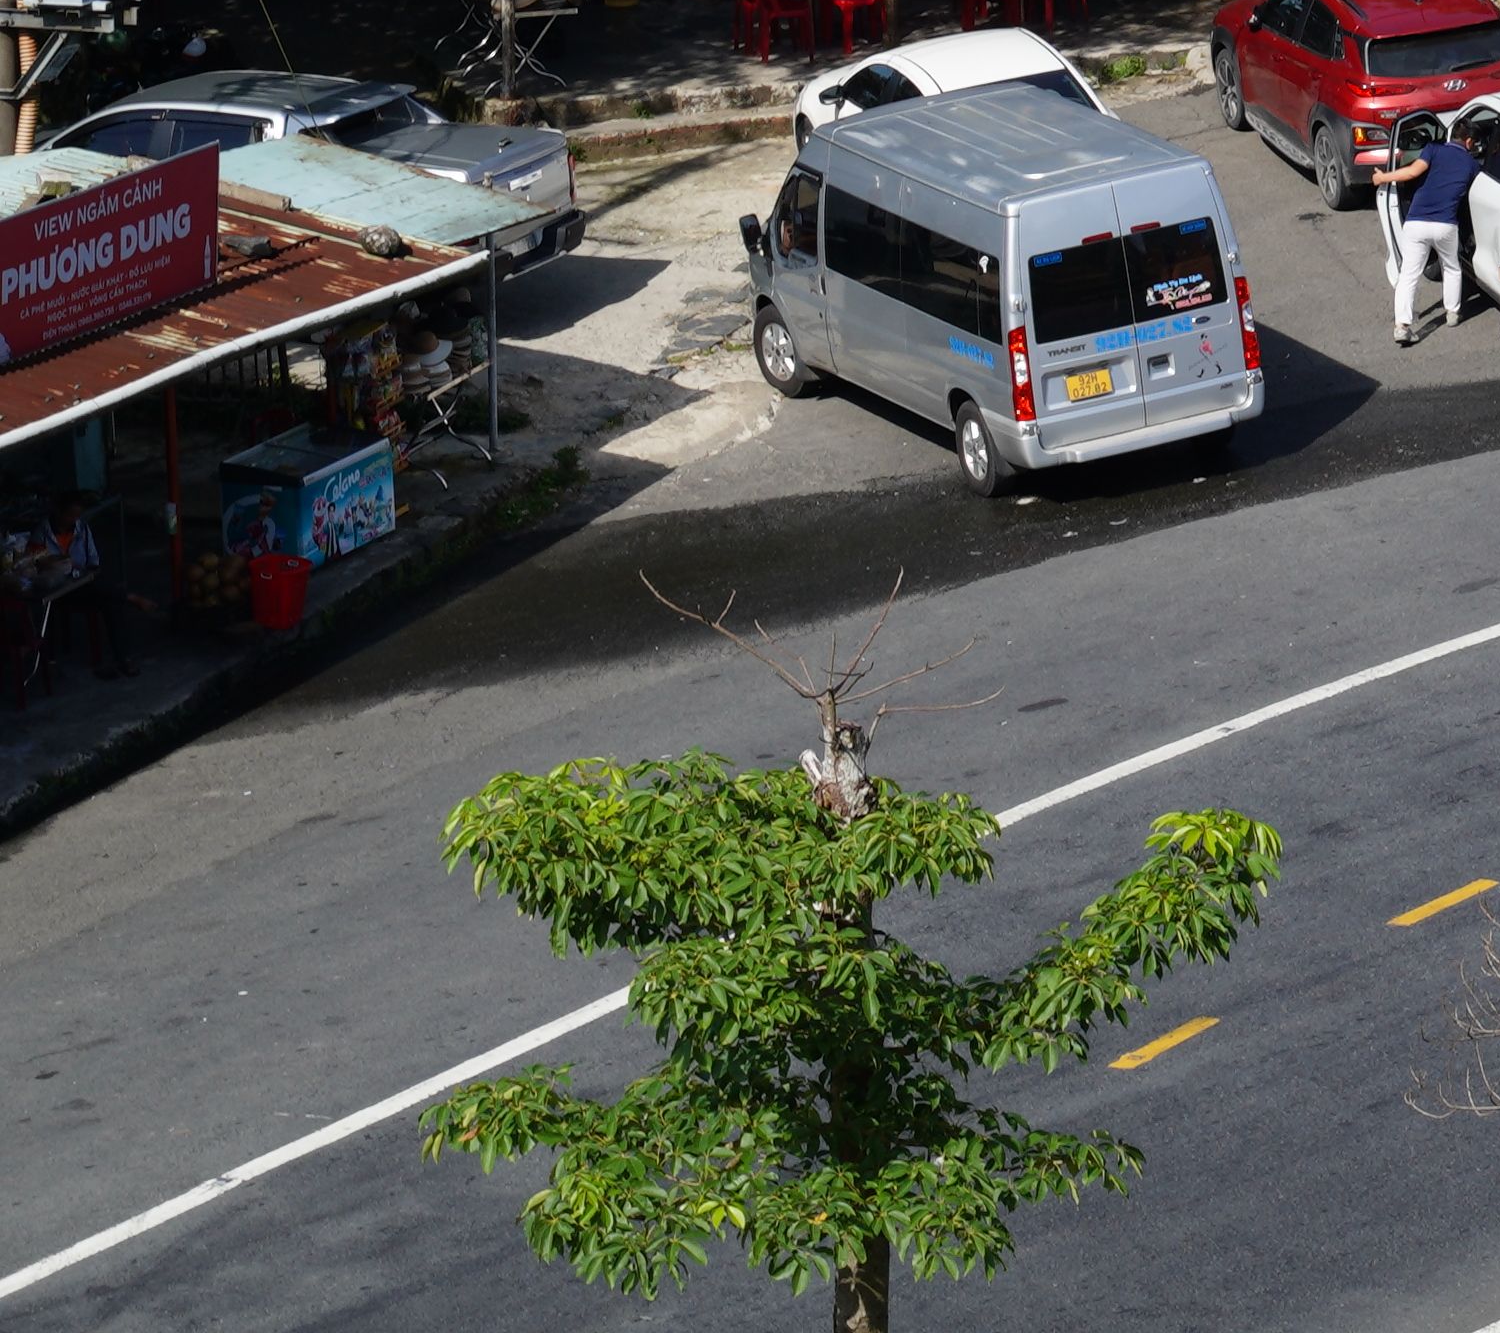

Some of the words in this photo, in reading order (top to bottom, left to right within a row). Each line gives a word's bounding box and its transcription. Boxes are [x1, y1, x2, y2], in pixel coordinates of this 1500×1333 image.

[34, 210, 74, 242] VIEW
[76, 188, 120, 225] NGẮM
[122, 177, 164, 209] CẢNH
[1, 232, 115, 306] PHƯƠNG
[120, 203, 192, 262] DUNG
[1047, 344, 1086, 358] TRANSIT
[1078, 373, 1099, 389] 92H
